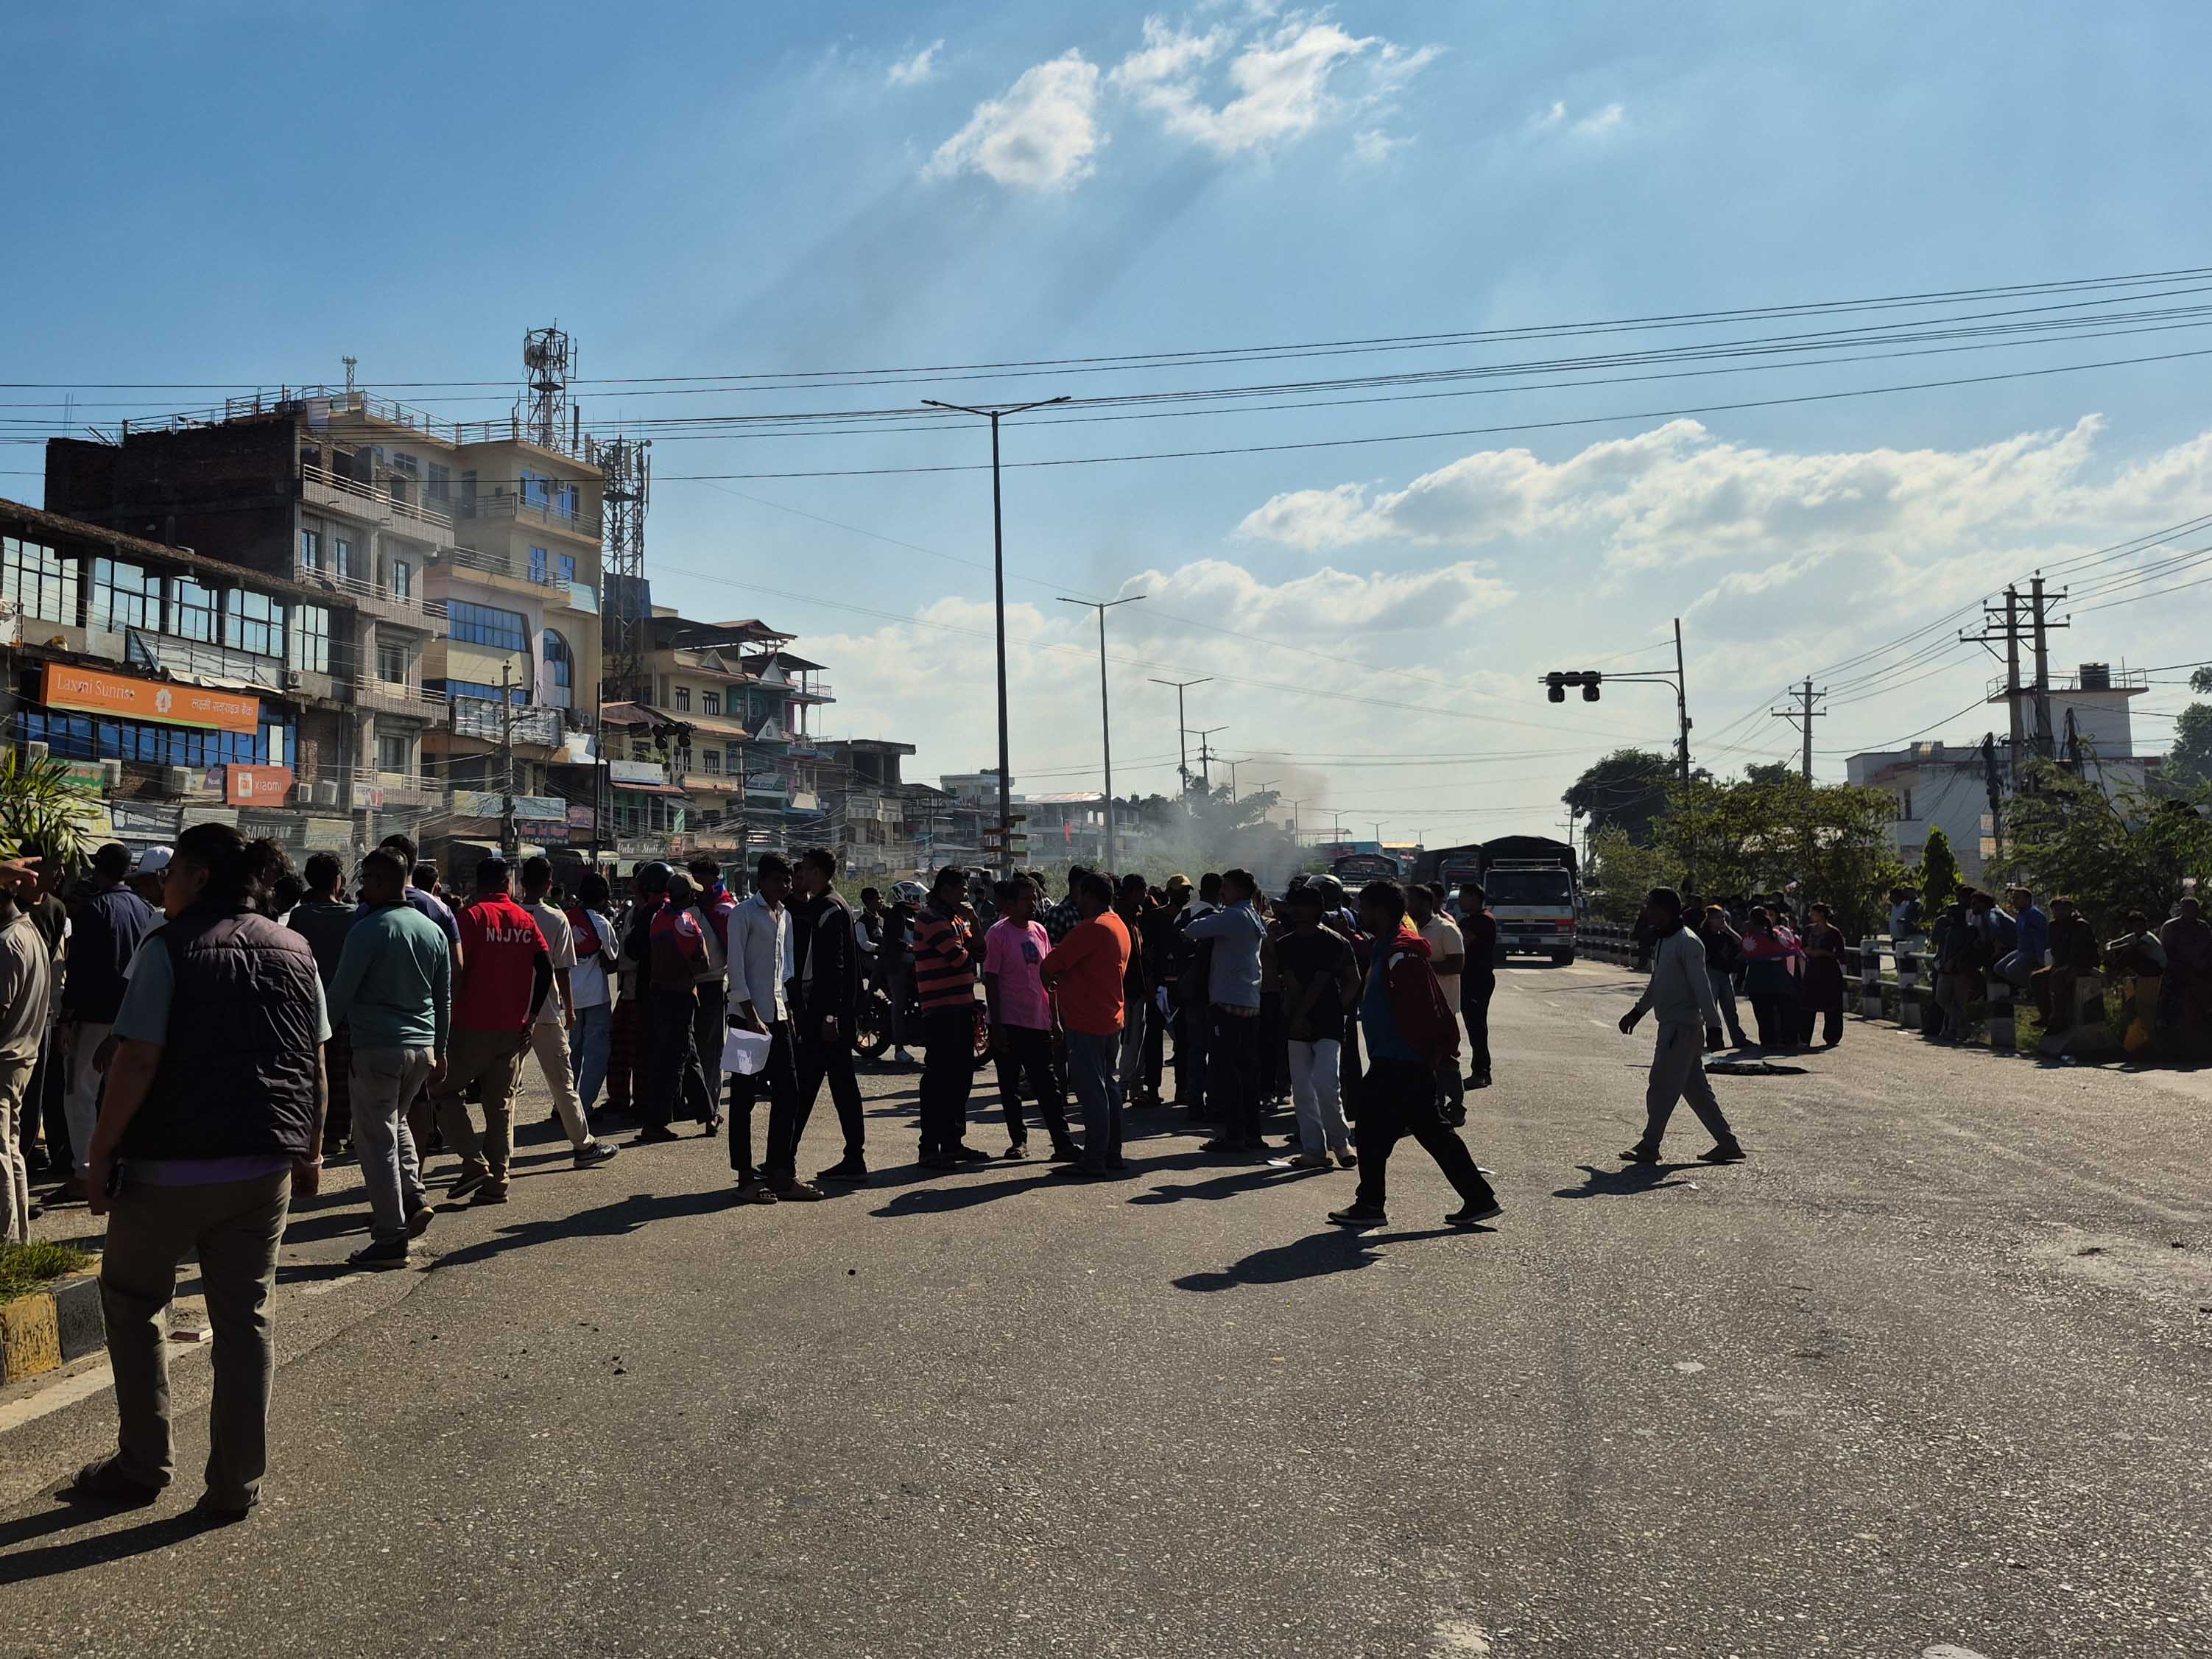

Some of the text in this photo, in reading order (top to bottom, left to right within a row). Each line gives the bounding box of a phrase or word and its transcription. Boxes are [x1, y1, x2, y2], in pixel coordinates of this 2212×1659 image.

[57, 673, 94, 695] Laxmi
[95, 680, 135, 701] Sunrise
[254, 781, 283, 791] xiaomi
